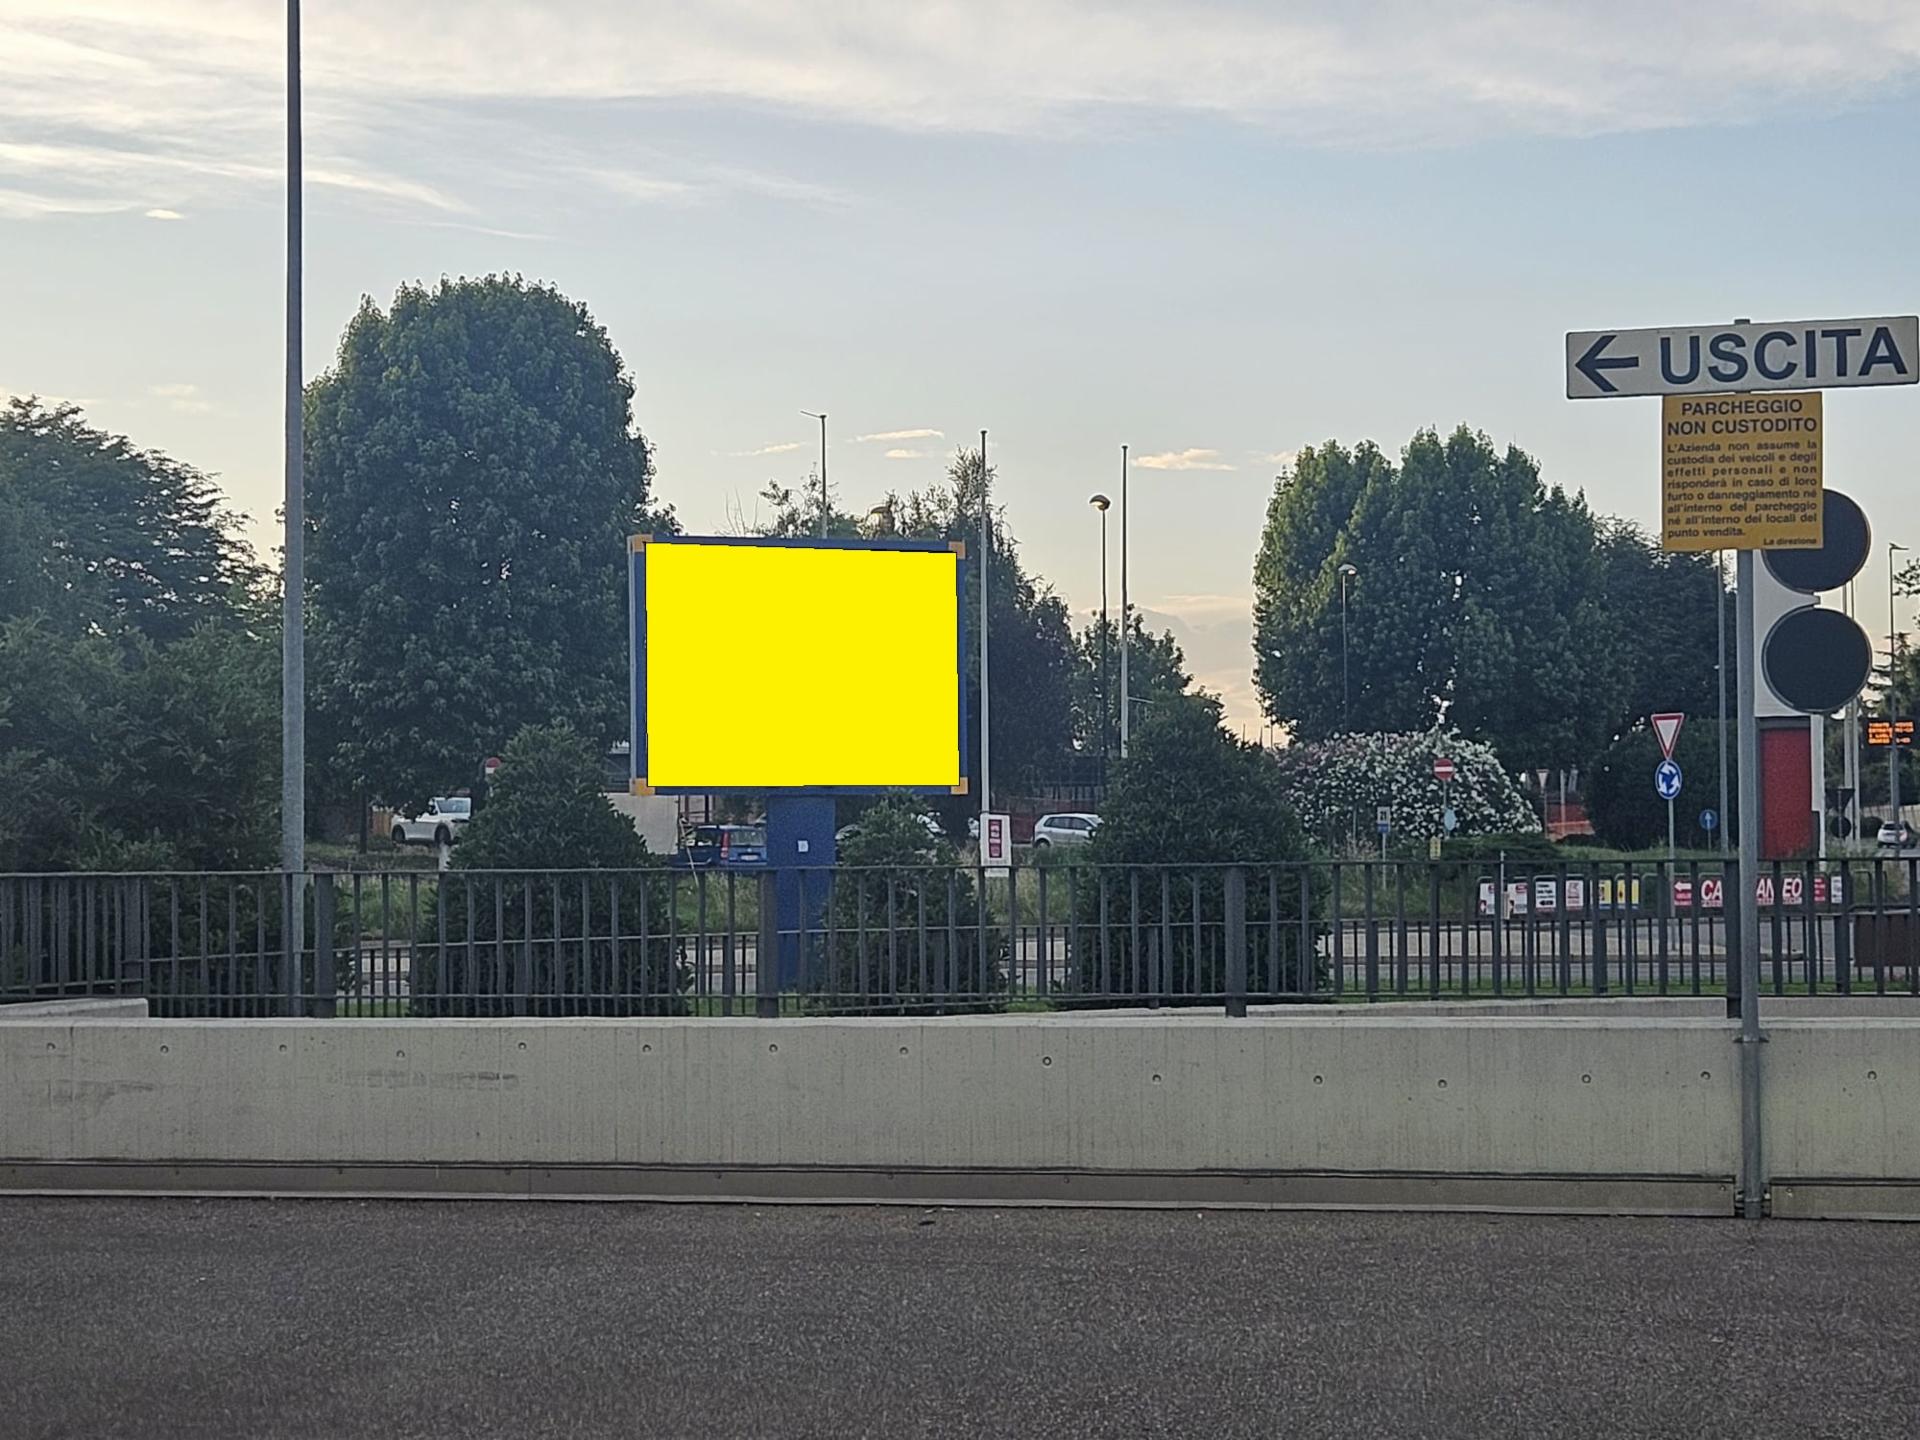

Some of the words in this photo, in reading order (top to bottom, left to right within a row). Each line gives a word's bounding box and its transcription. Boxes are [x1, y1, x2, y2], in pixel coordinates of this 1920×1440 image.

[1660, 326, 1908, 385] USCITA
[1682, 399, 1802, 415] PARCHEGGIO
[1668, 421, 1705, 435] NON
[1712, 418, 1816, 434] CUSTODITO
[1668, 442, 1720, 453] L'Azienda
[1728, 442, 1749, 450] non
[1757, 441, 1800, 450] assume
[1808, 440, 1816, 449] la
[1668, 454, 1714, 465] custodia
[1719, 453, 1735, 463] dei
[1740, 452, 1774, 462] veicoli
[1790, 451, 1816, 463] degli
[1668, 468, 1705, 477] effetti
[1713, 466, 1772, 477] personali
[1668, 479, 1726, 490] risponderà
[1733, 478, 1742, 487] in
[1779, 477, 1789, 486] di
[1795, 476, 1816, 486] loro
[1668, 492, 1694, 501] furto
[1708, 490, 1799, 504] danneggiamento
[1804, 490, 1816, 498] né
[1668, 503, 1722, 513] all'interno
[1730, 503, 1746, 512] del
[1755, 502, 1816, 513] parcheggio
[1668, 515, 1680, 525] né
[1685, 514, 1740, 524] all'interno
[1766, 513, 1795, 522] locali
[1668, 528, 1699, 539] punto
[1703, 527, 1745, 537] vendita.
